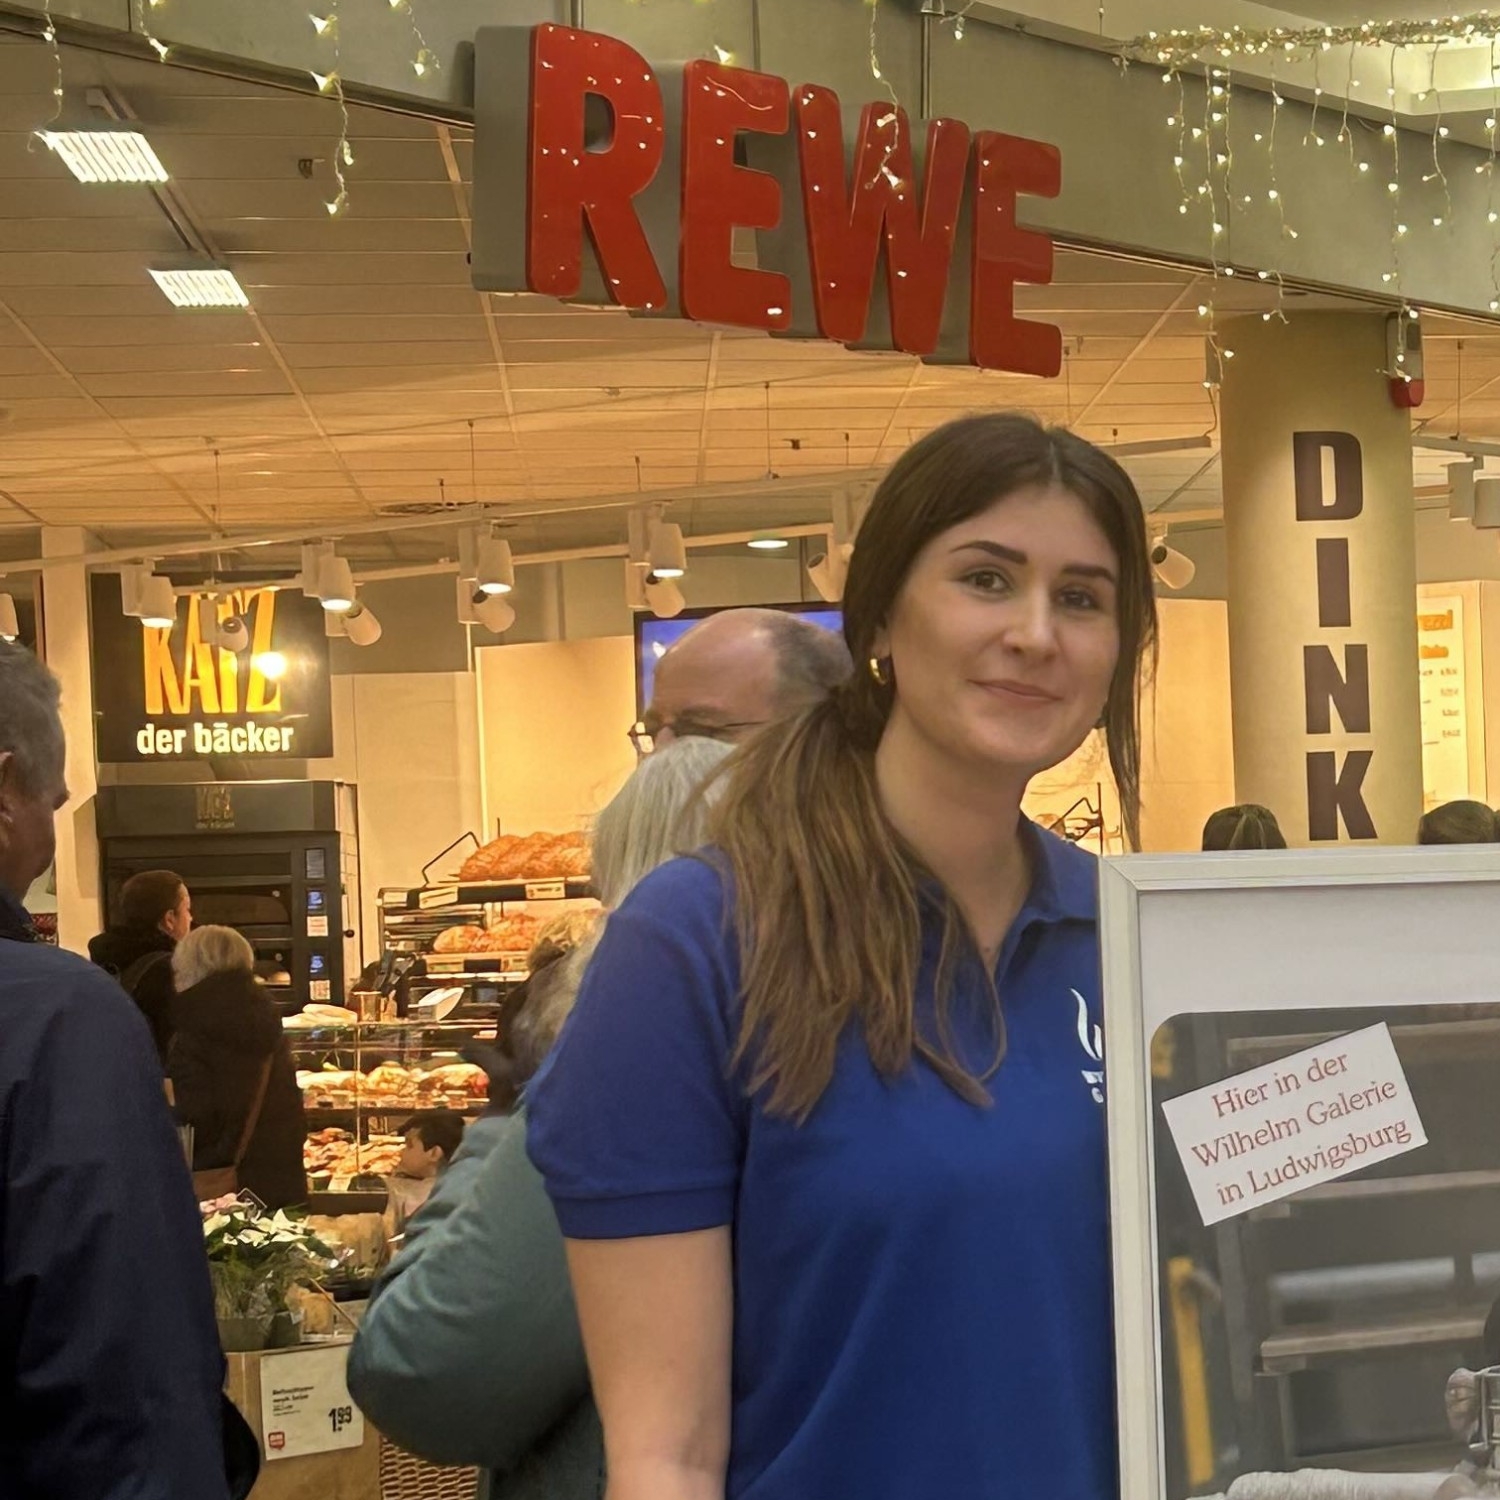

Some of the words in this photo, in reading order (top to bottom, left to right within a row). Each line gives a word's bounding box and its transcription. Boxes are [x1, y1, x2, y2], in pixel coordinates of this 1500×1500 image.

[527, 23, 1062, 377] REWE
[1293, 431, 1378, 841] DINK
[136, 722, 187, 755] der
[193, 720, 295, 754] bäcker
[1190, 1114, 1301, 1168] Wilhelm
[1306, 1079, 1398, 1126] Galerie
[1211, 1080, 1270, 1118] Hier
[1274, 1072, 1301, 1096] in
[1307, 1053, 1350, 1084] der
[1216, 1181, 1245, 1206] in
[1246, 1119, 1412, 1194] Ludwigsburg
